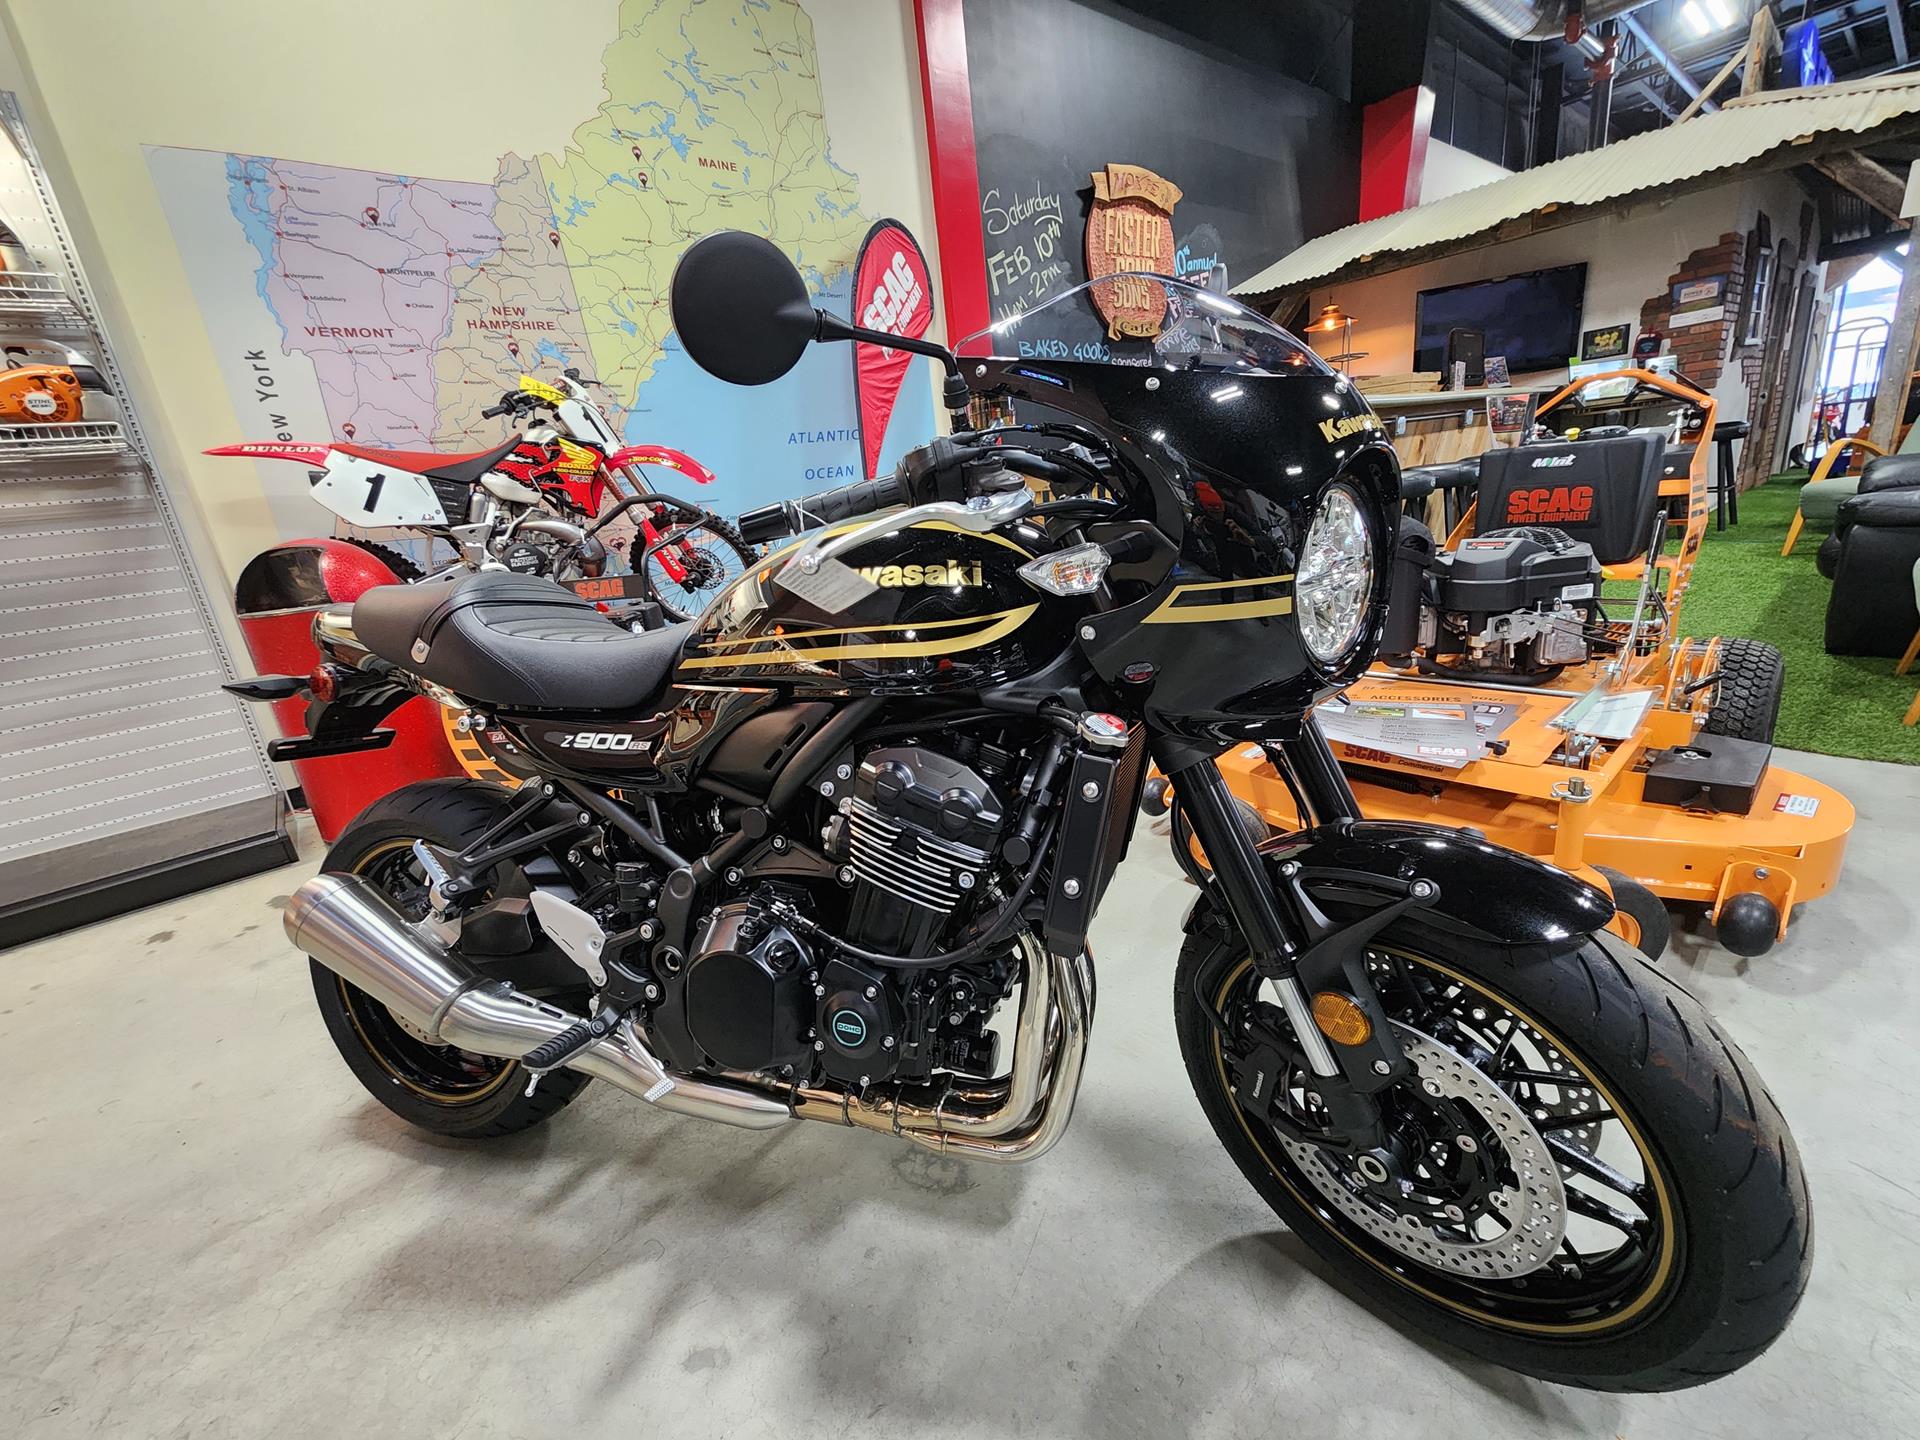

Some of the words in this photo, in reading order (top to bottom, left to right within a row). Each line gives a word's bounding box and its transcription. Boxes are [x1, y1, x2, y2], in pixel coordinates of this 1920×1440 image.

[698, 157, 738, 172] MAINE
[982, 179, 1063, 235] Saturday
[1104, 208, 1162, 259] FASTER
[987, 245, 1032, 295] FEB
[1033, 220, 1062, 262] 10th
[1187, 251, 1218, 272] annual
[289, 272, 325, 280] Vergennes
[386, 267, 436, 278] MONTPELIER
[309, 295, 347, 303] Middlebury
[863, 251, 915, 334] SCAG
[492, 306, 526, 317] NEW
[304, 326, 395, 338] VERMONT
[467, 319, 556, 331] HAMPSHIRE
[1120, 320, 1153, 334] Café
[1018, 339, 1069, 358] BAKED
[1073, 341, 1111, 362] GOODS
[244, 350, 279, 403] York
[268, 413, 293, 442] ew
[582, 405, 608, 443] 1
[788, 428, 860, 445] ATLANTIC
[241, 445, 323, 453] DUNLOP
[558, 462, 597, 470] HONDA
[804, 464, 854, 480] OCEAN
[363, 473, 386, 513] 1
[1507, 486, 1594, 514] SCAG
[1507, 513, 1537, 523] POWER
[1538, 511, 1591, 523] EQUIPMENT
[510, 556, 538, 564] FACTORY
[511, 560, 539, 568] RACING
[850, 559, 983, 588] wasaki
[575, 578, 625, 600] SCAG
[1370, 694, 1463, 703] ACCESSORIES
[1343, 744, 1392, 764] SCAG
[1397, 759, 1445, 773] Commercial
[837, 1022, 861, 1035] DOHC
